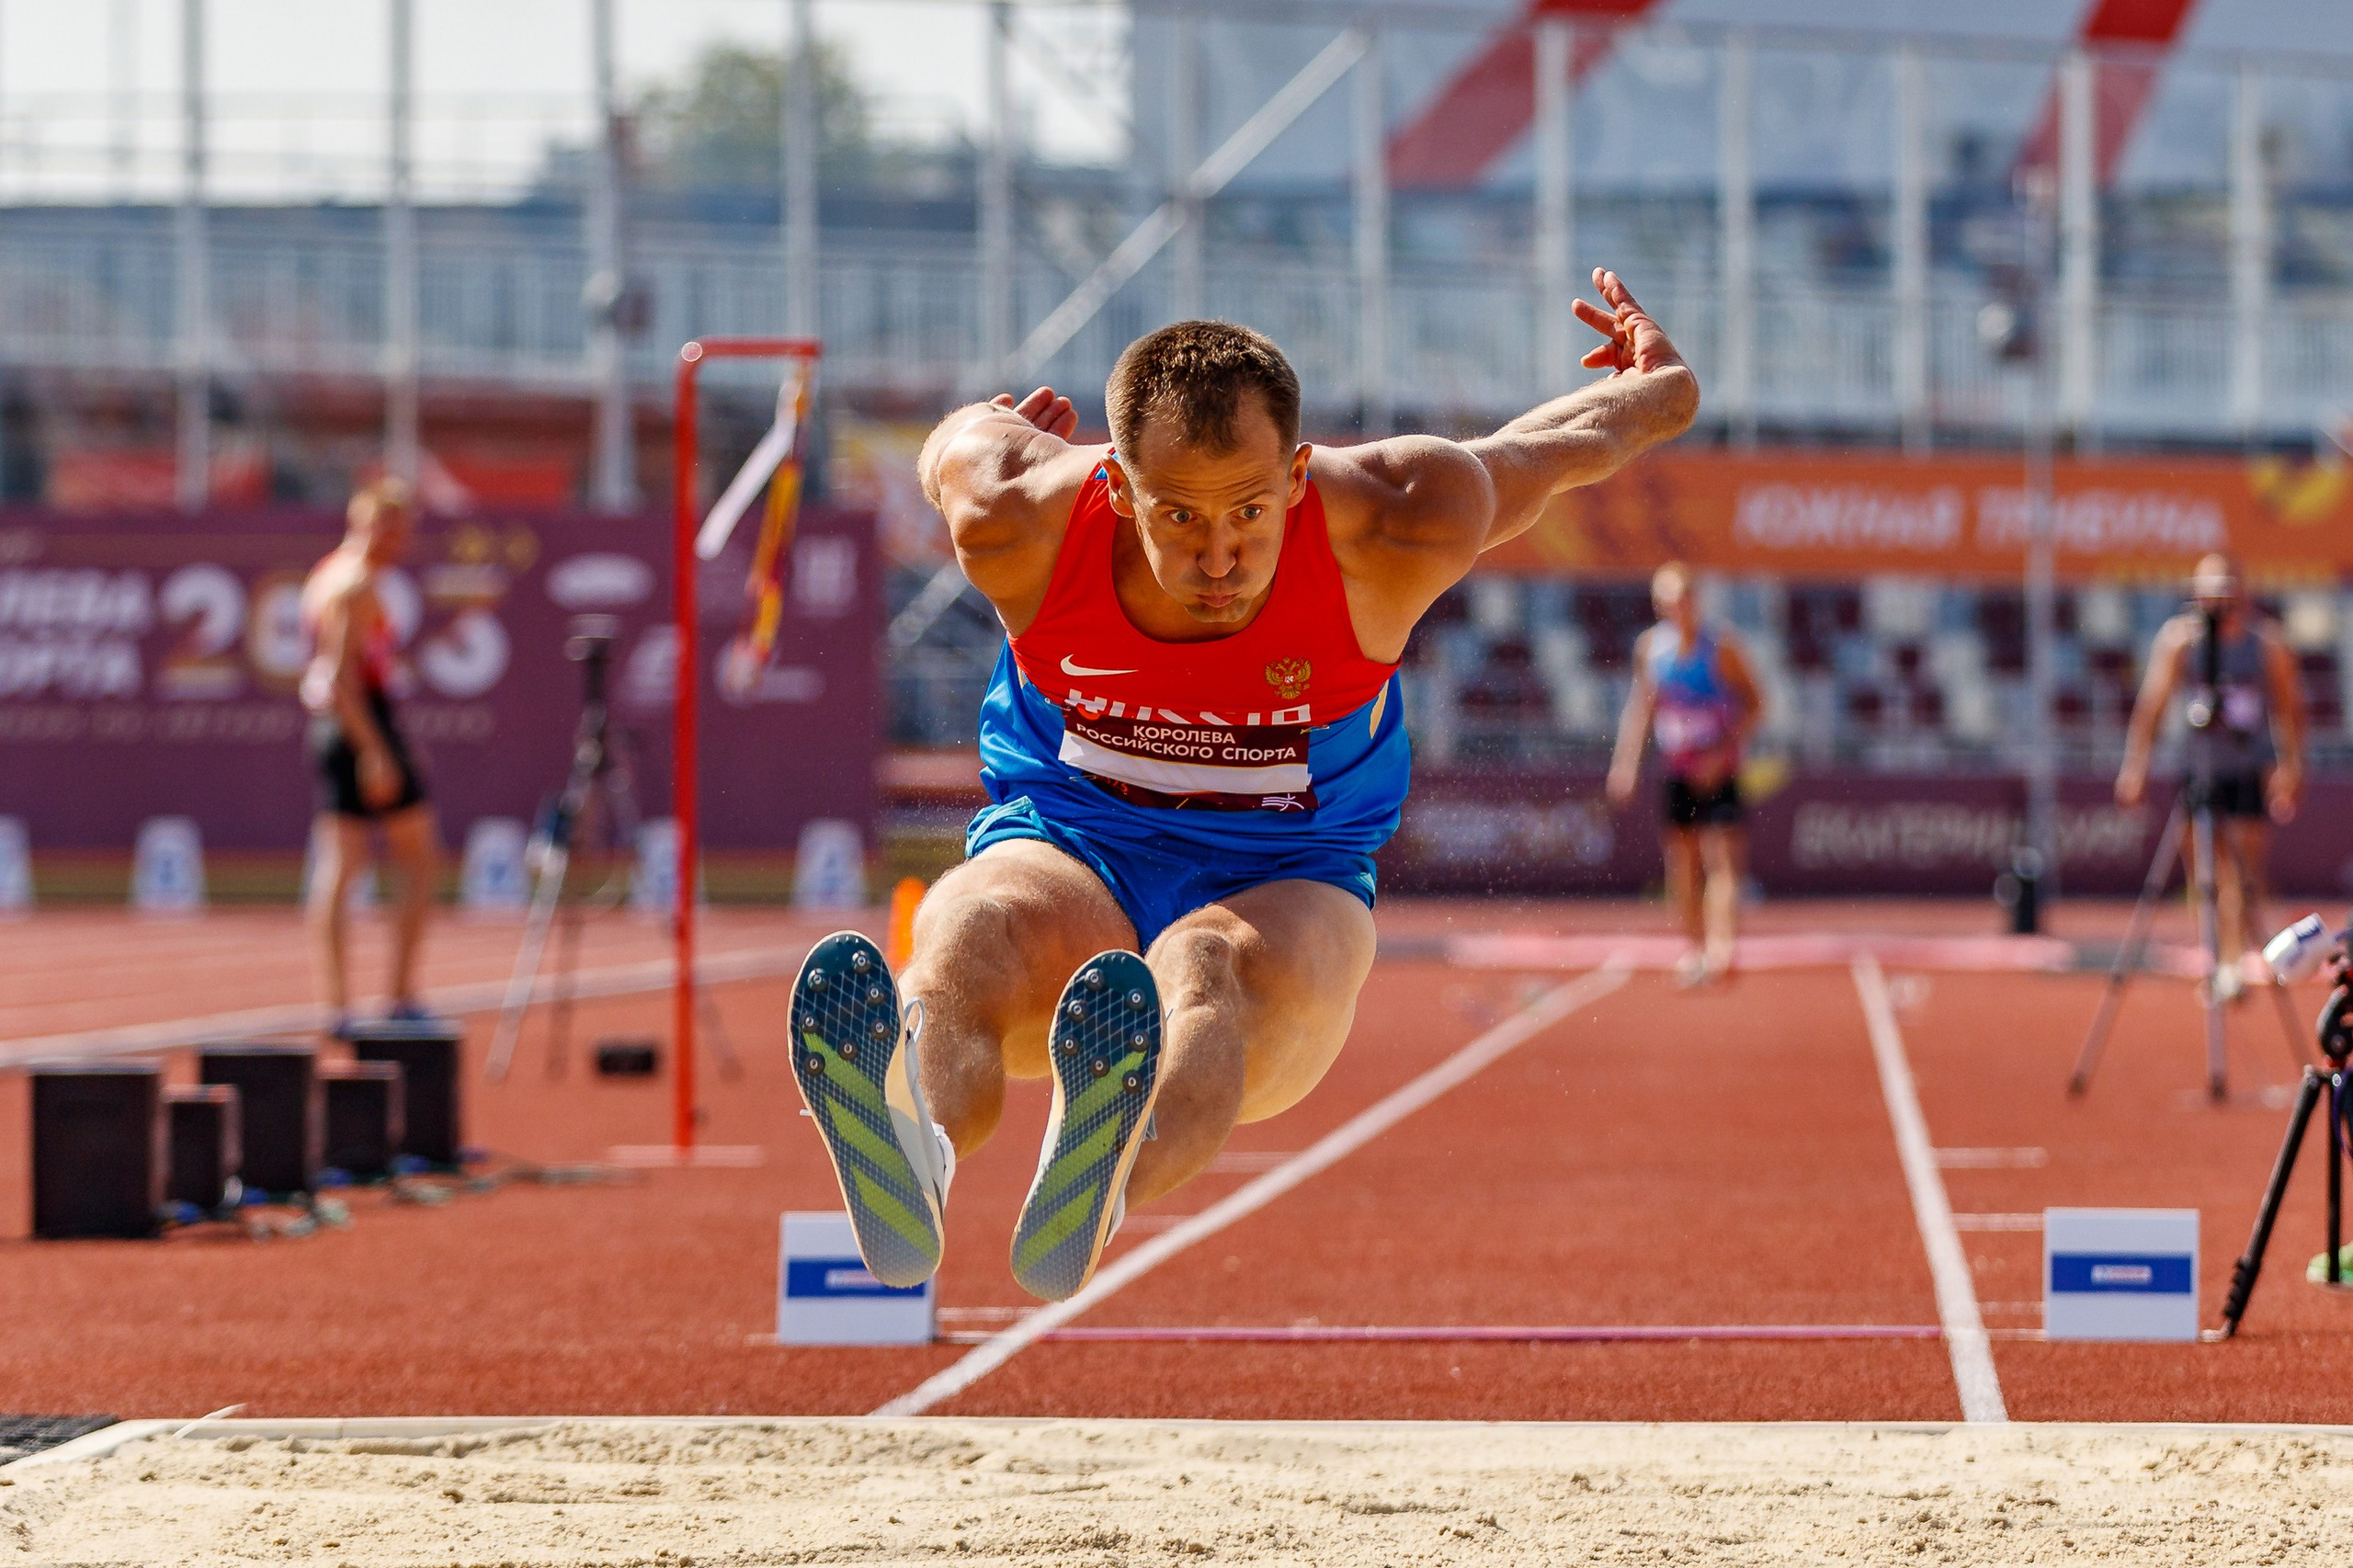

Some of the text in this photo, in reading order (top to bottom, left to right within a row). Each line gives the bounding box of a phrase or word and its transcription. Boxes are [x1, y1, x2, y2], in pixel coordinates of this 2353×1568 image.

[1075, 722, 1297, 761] РОССИЙСКОГО СПОРТА
[1132, 724, 1236, 744] КОРОЛЕВА
